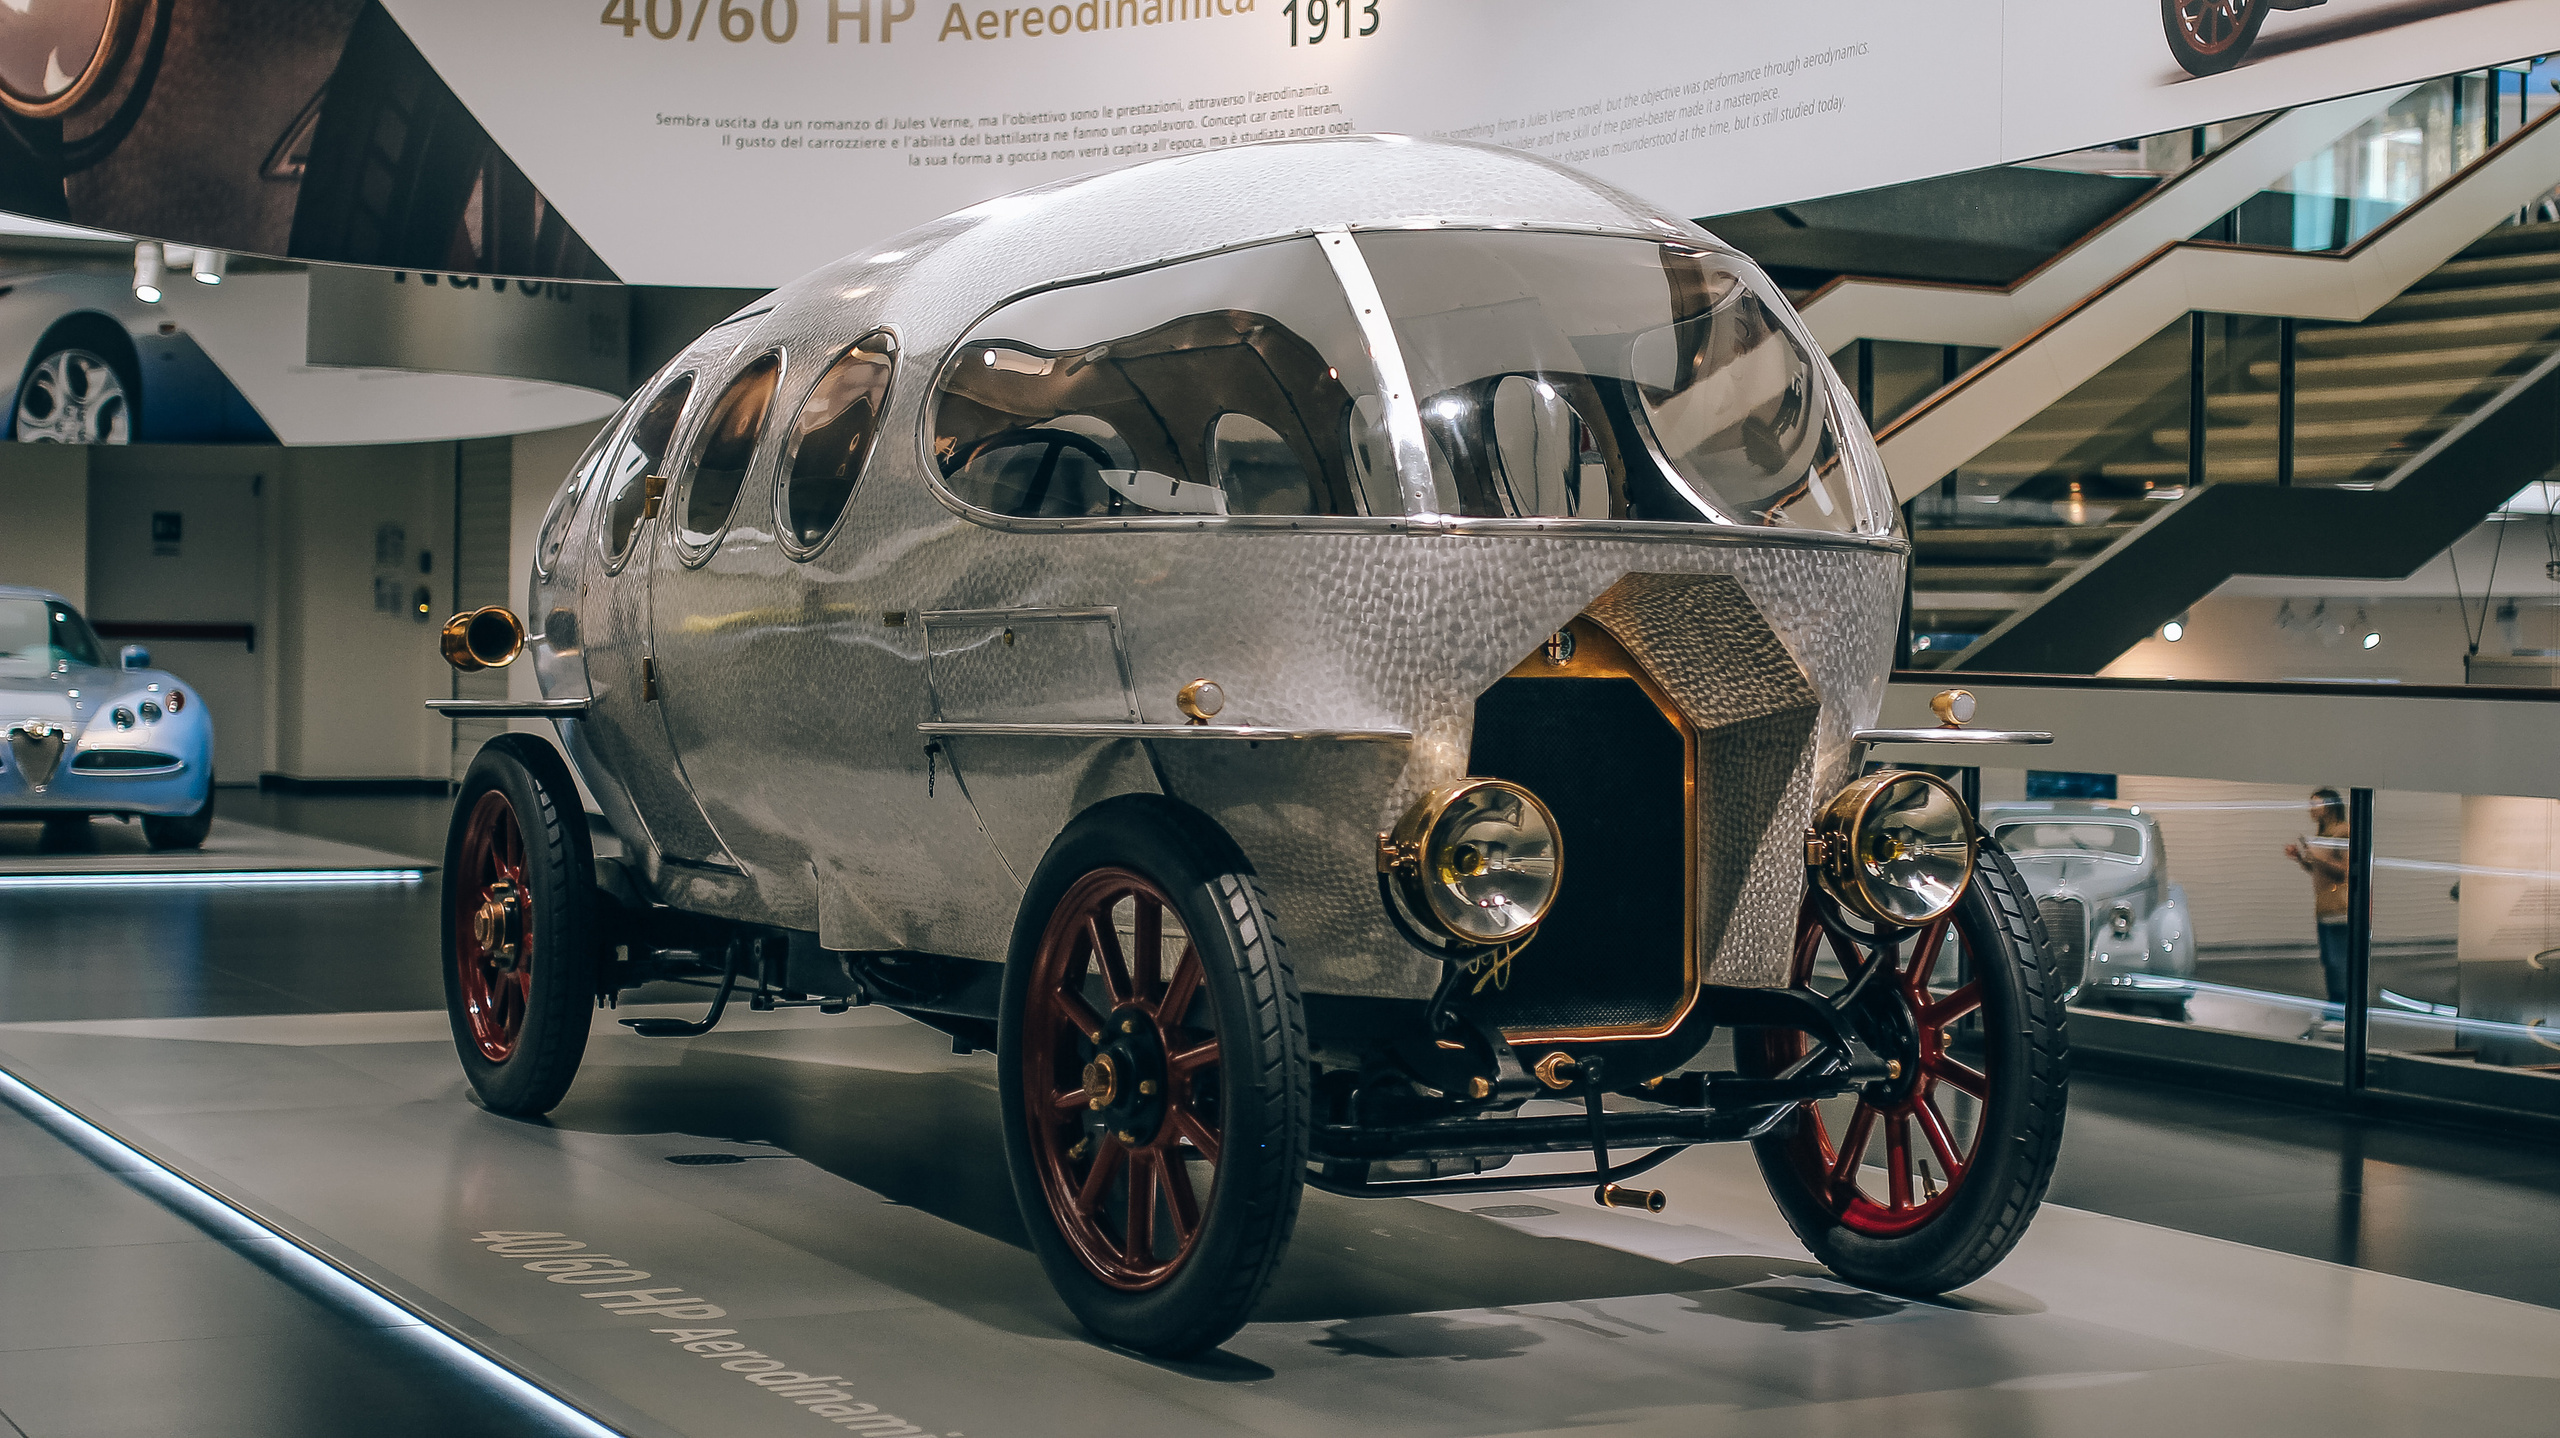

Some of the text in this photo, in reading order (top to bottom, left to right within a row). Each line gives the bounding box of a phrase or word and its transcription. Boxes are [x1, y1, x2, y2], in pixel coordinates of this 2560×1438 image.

[601, 0, 797, 43] 40/60
[827, 0, 916, 43] HP
[1283, 0, 1379, 47] 1913
[655, 83, 1332, 131] Sembra uscita da un romanzo di Jules Verne, ma l'obiettivo sono le prestazioni, attraverso l'aerodinamica.
[1451, 122, 1495, 140] something
[1497, 118, 1518, 133] from
[1520, 119, 1525, 129] a
[1526, 113, 1548, 128] Jules
[1550, 108, 1575, 123] Verne
[1577, 100, 1603, 118] novel,
[1606, 98, 1622, 112] but
[1624, 94, 1638, 108] the
[1641, 85, 1681, 107] objective
[1683, 81, 1701, 96] was
[1703, 67, 1761, 93] performance
[1763, 55, 1801, 78] through
[1803, 41, 1869, 69] aerodynamics.
[1537, 130, 1554, 147] and
[1556, 127, 1571, 144] the
[1572, 123, 1590, 140] skill
[1592, 119, 1602, 137] of
[1604, 118, 1618, 134] the
[1620, 108, 1677, 134] panel-beater
[1678, 101, 1704, 120] made
[1706, 98, 1713, 114] it
[1715, 101, 1721, 112] a
[1723, 85, 1780, 110] masterpiece.
[722, 134, 730, 147] Il
[735, 136, 776, 150] gusto
[781, 136, 803, 148] del
[807, 137, 886, 150] carrozziere
[890, 139, 899, 149] e
[959, 132, 981, 147] del
[1053, 130, 1068, 142] ne
[1073, 125, 1108, 140] fanno
[1111, 125, 1127, 137] un
[1130, 118, 1197, 138] capolavoro.
[1200, 112, 1247, 130] Concept
[1250, 111, 1267, 123] car
[1270, 108, 1295, 121] ante
[1297, 101, 1343, 118] litteram,
[908, 153, 919, 167] la
[924, 155, 947, 166] sua
[952, 151, 991, 166] forma
[996, 154, 1003, 164] a
[1007, 149, 1047, 166] goccia
[1051, 148, 1076, 161] non
[1078, 143, 1109, 158] verrà
[1112, 141, 1149, 158] capita
[1209, 134, 1227, 146] ma
[1240, 126, 1286, 143] studiata
[1289, 125, 1325, 138] ancora
[1564, 147, 1590, 165] shape
[1592, 146, 1609, 159] was
[1611, 130, 1677, 155] misunderstood
[1679, 128, 1689, 142] at
[1691, 124, 1706, 140] the
[1709, 119, 1731, 137] time,
[1734, 115, 1750, 131] but
[1752, 113, 1760, 128] is
[1762, 107, 1778, 126] still
[1780, 98, 1815, 122] studied
[1817, 95, 1846, 115] today.
[471, 1230, 651, 1285] 40/60
[580, 1287, 727, 1320] HP
